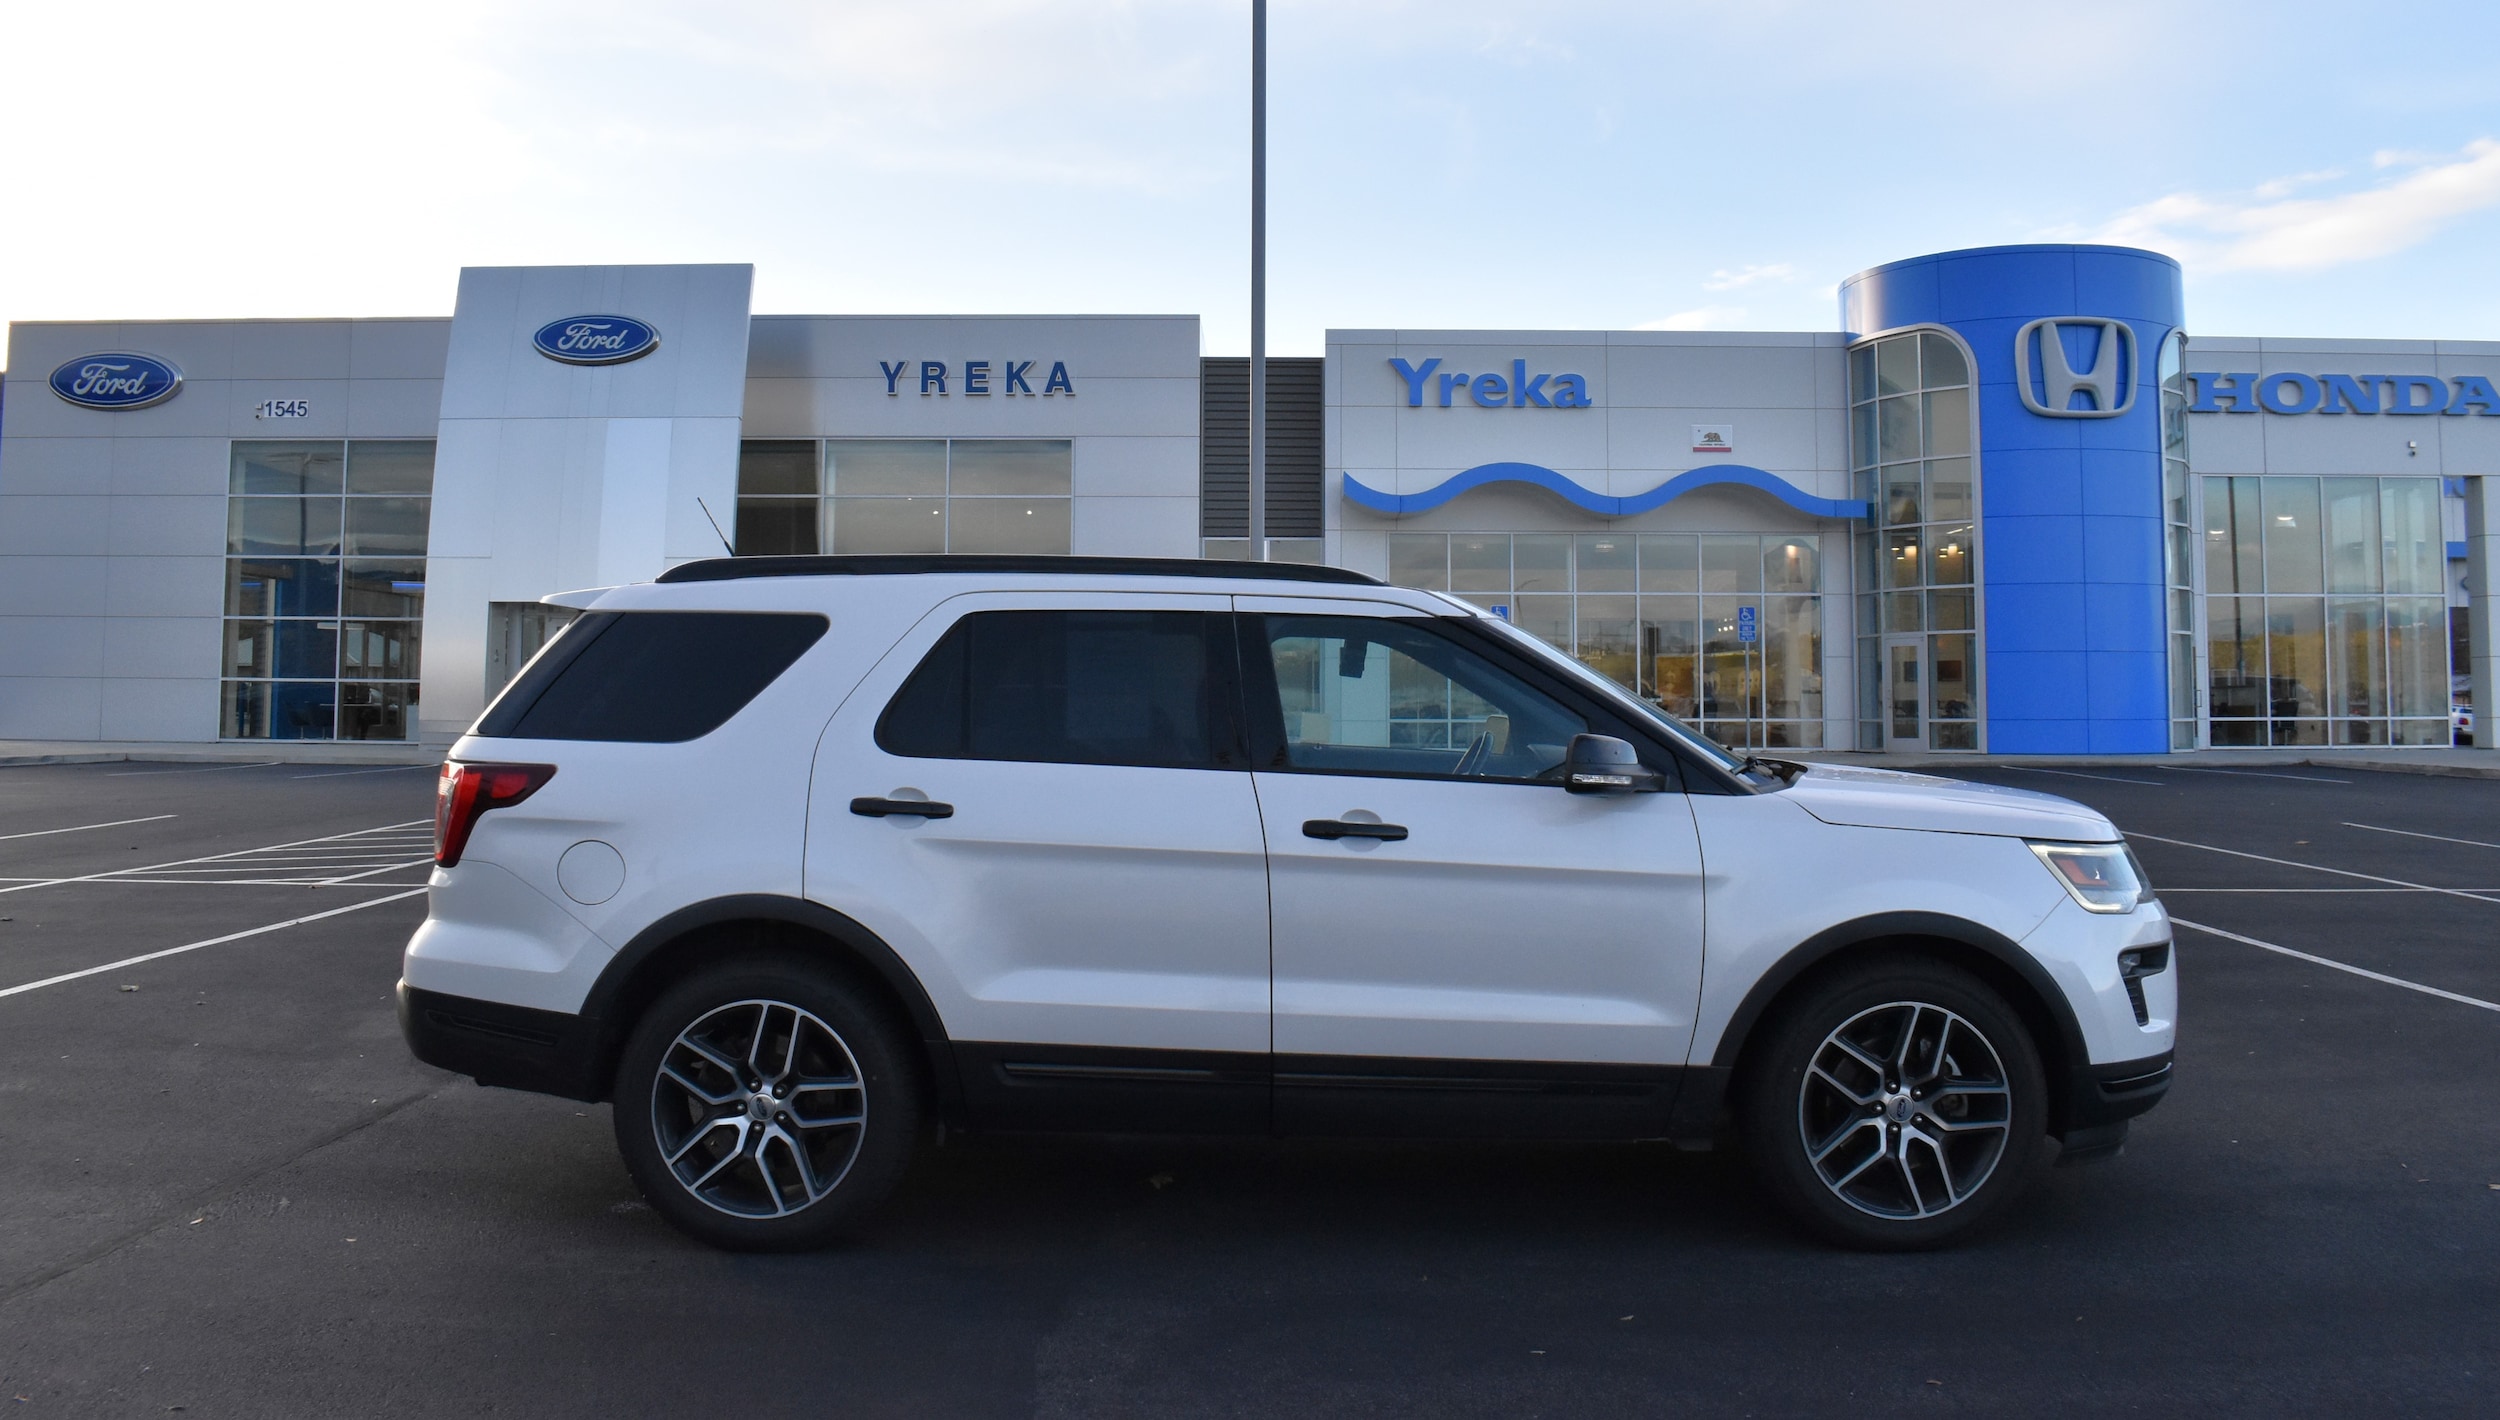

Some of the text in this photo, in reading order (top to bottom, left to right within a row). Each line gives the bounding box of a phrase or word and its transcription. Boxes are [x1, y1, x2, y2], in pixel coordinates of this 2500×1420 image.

[557, 323, 629, 350] Ford
[72, 363, 148, 395] Ford
[879, 361, 1075, 396] YREKA
[1388, 357, 1592, 408] Yreka
[2187, 372, 2500, 416] HONDA
[265, 401, 308, 417] 1545
